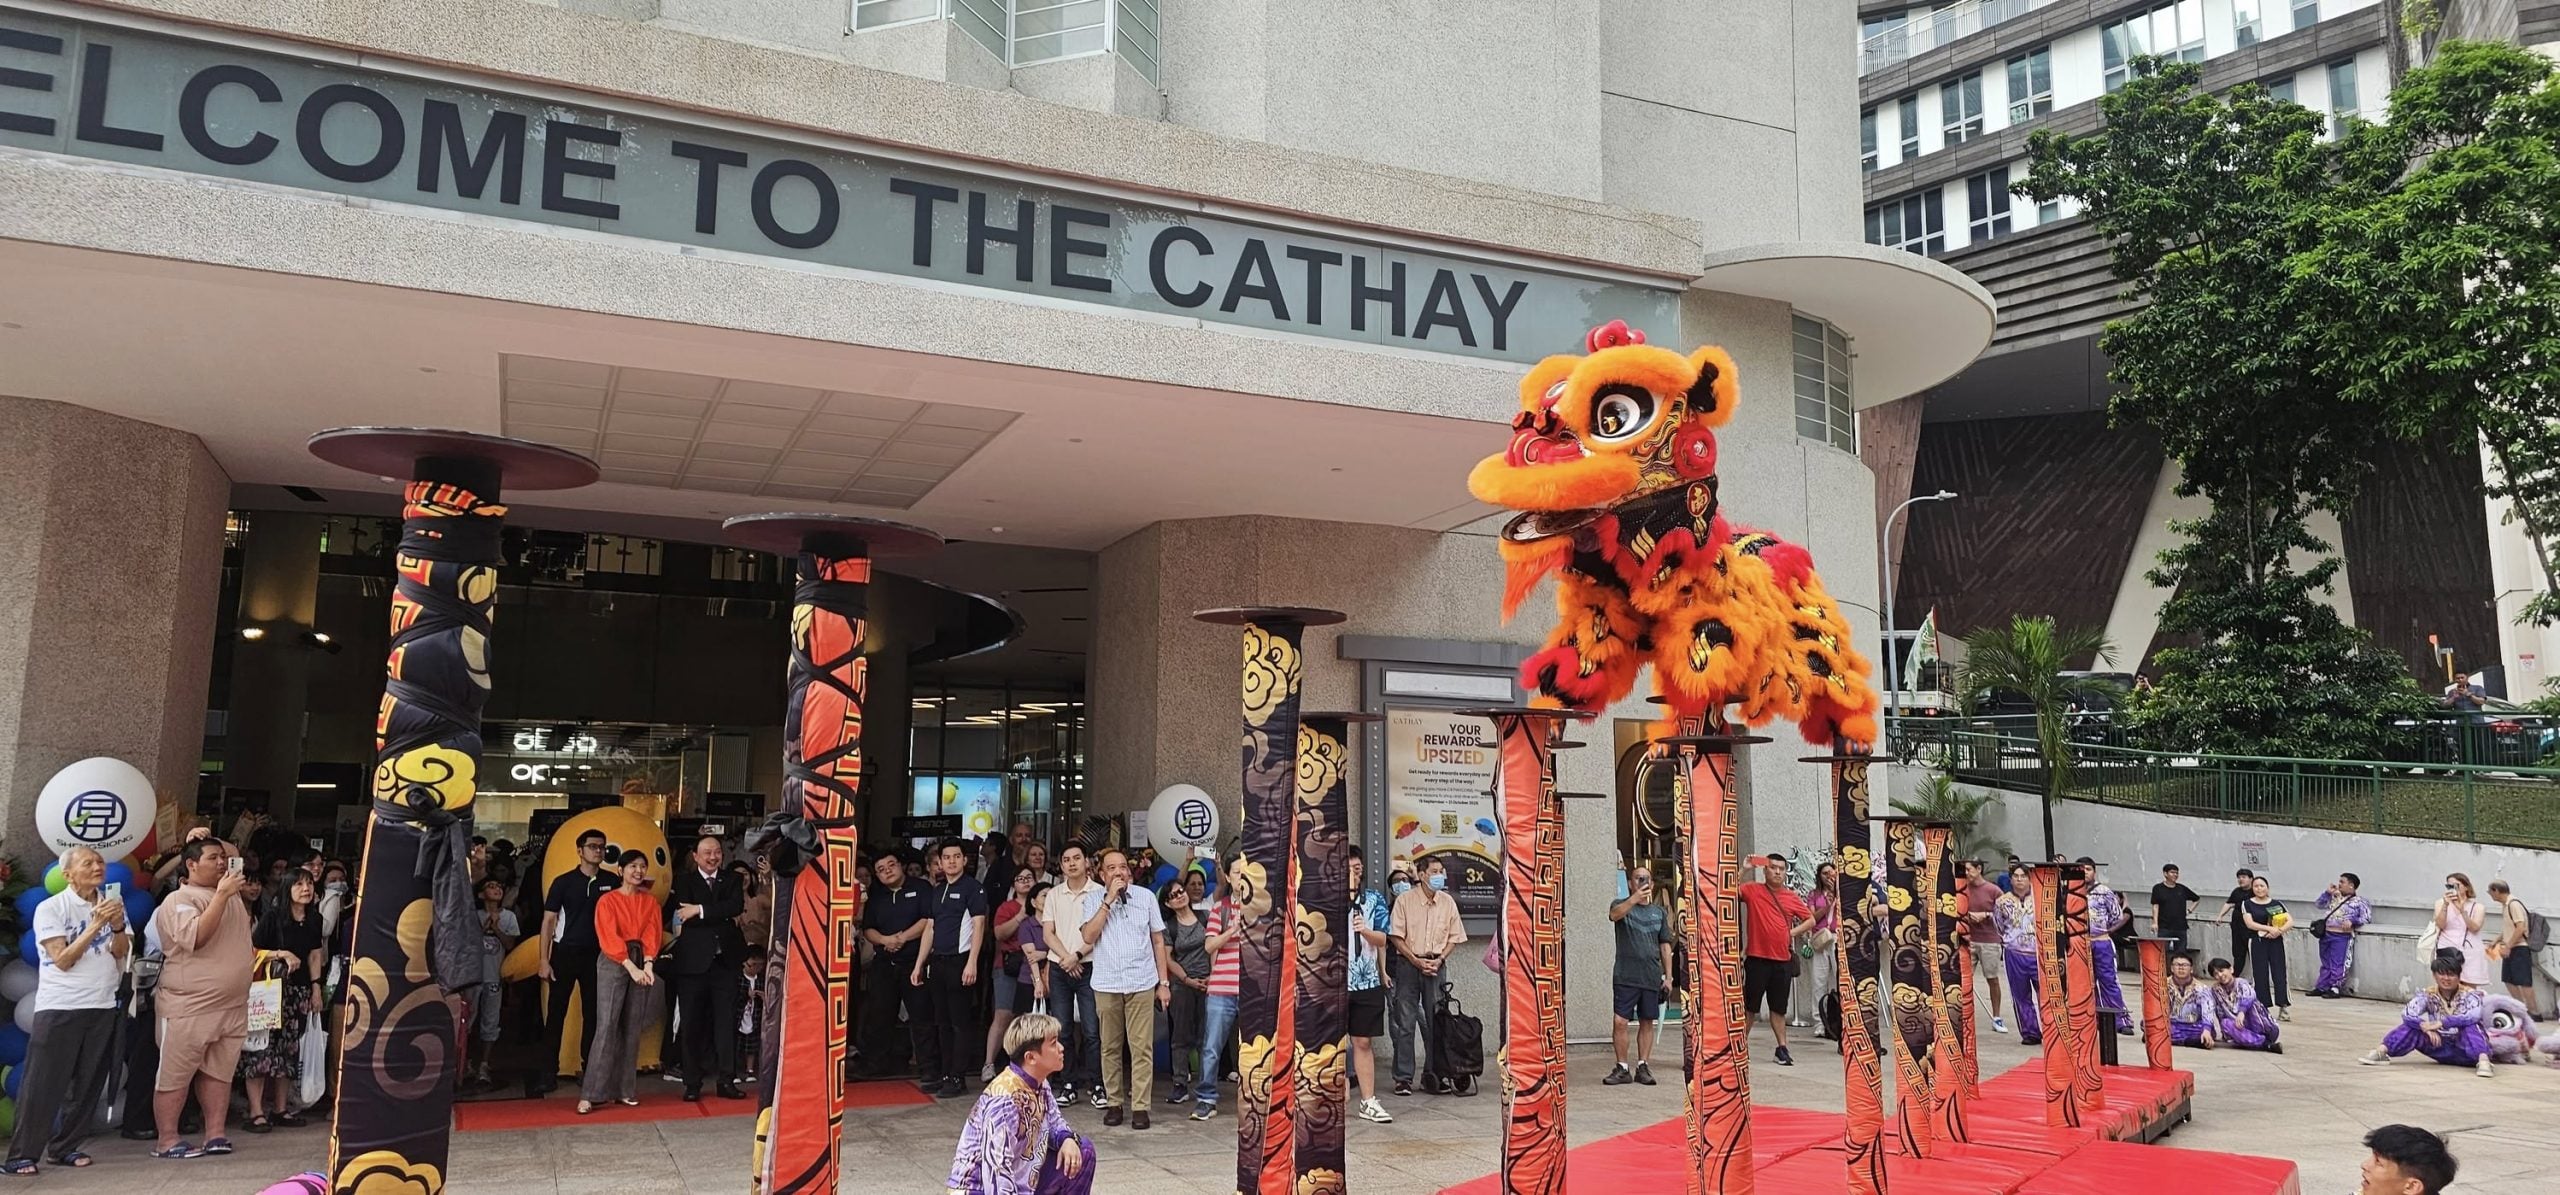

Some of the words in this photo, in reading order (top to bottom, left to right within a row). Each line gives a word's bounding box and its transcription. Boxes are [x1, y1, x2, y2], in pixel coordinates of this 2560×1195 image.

[671, 141, 841, 249] TO
[889, 177, 1112, 293] THE
[1149, 226, 1529, 351] CATHAY
[1449, 723, 1481, 735] YOUR
[1424, 734, 1482, 747] REWARDS
[1416, 745, 1485, 765] UPSIZED
[1466, 867, 1484, 884] 3x
